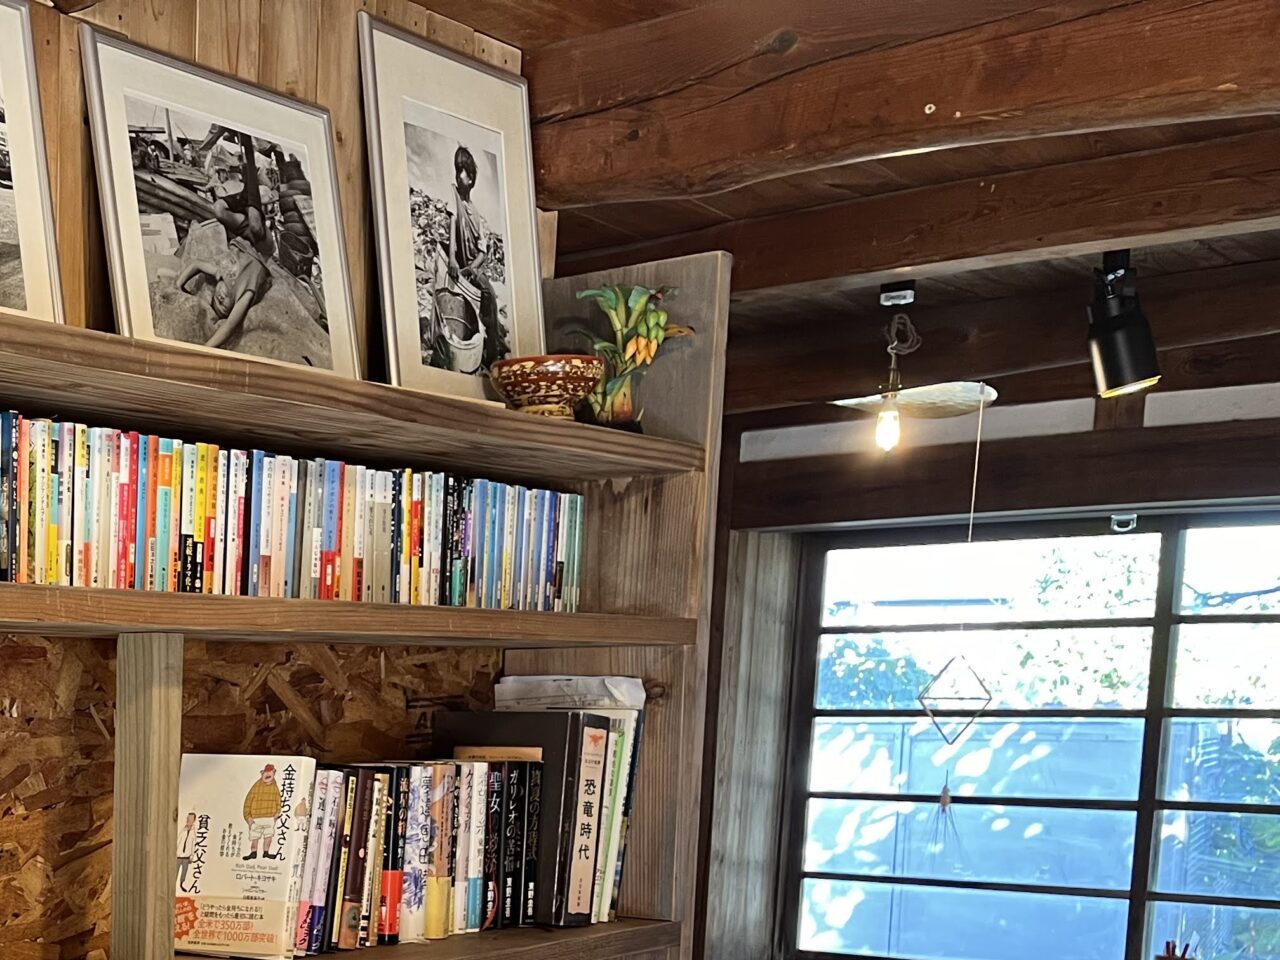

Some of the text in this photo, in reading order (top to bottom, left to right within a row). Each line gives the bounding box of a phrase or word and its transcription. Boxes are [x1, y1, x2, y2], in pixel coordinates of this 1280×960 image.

[188, 814, 211, 895] 貧乏父さん
[274, 764, 297, 861] 金持ち父さん
[504, 770, 519, 872] ガリレオの苦悩
[578, 779, 596, 861] 恐竜時代
